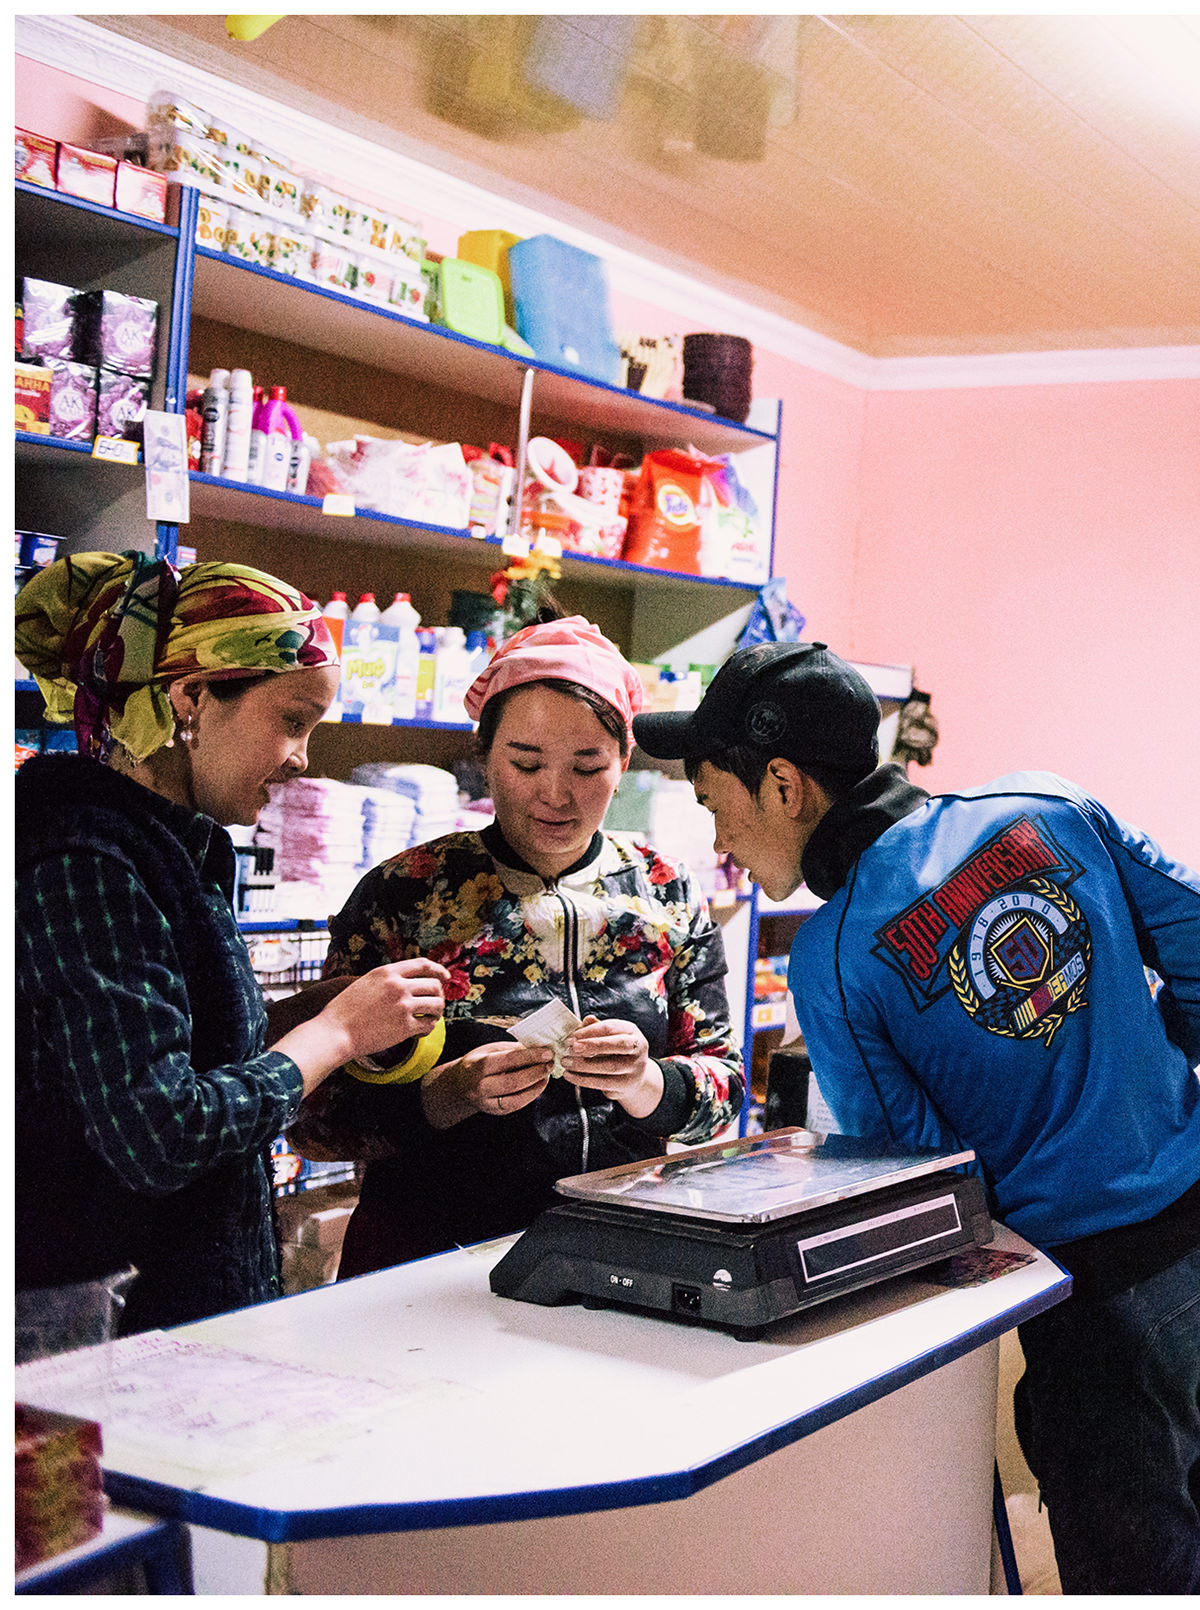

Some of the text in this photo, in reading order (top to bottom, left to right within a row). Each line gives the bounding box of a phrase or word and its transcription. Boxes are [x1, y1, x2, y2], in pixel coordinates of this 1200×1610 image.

[886, 900, 950, 981] 50TH
[971, 894, 1051, 977] 1978 2010
[610, 1274, 633, 1287] ON OFF
